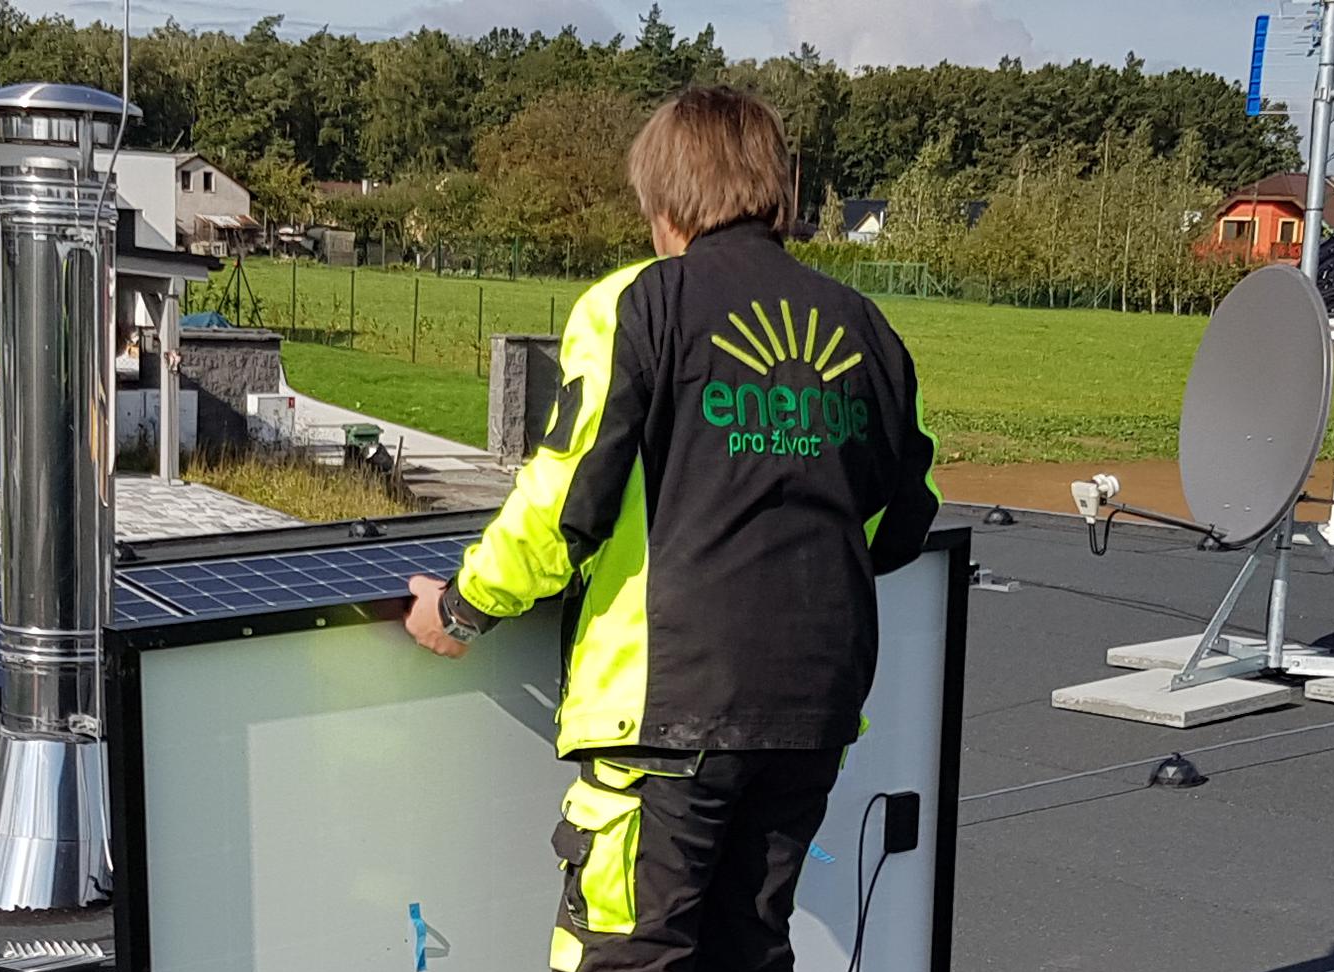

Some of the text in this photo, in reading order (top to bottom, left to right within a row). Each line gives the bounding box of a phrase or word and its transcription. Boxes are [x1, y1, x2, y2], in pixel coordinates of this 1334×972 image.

[702, 380, 868, 445] energie
[729, 429, 821, 457] pro život
